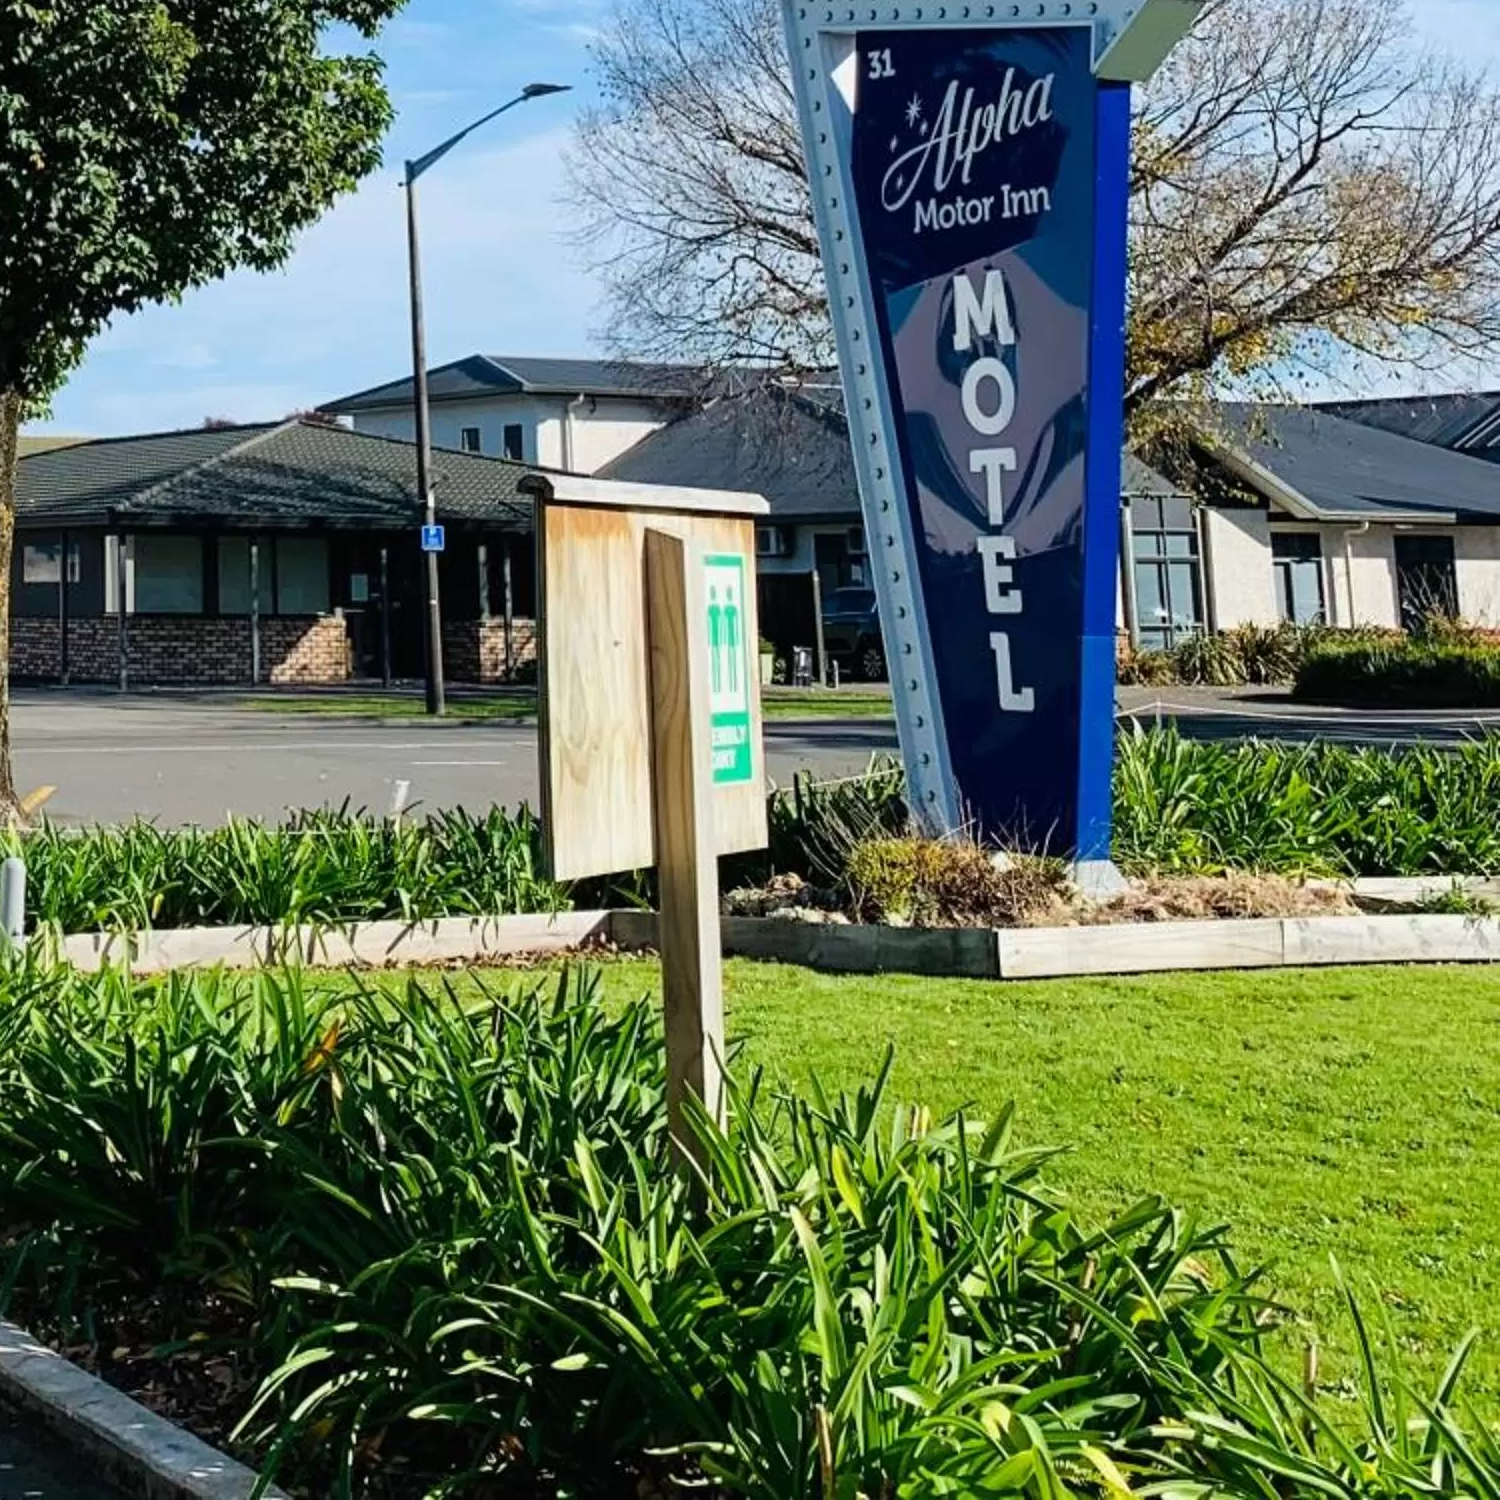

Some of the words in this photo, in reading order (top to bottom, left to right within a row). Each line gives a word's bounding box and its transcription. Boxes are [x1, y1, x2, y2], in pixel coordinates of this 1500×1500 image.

[867, 47, 896, 80] 31
[881, 67, 1055, 212] Alpha
[913, 195, 995, 234] Motor
[1001, 183, 1052, 219] Inn
[952, 268, 1035, 713] MOTEL
